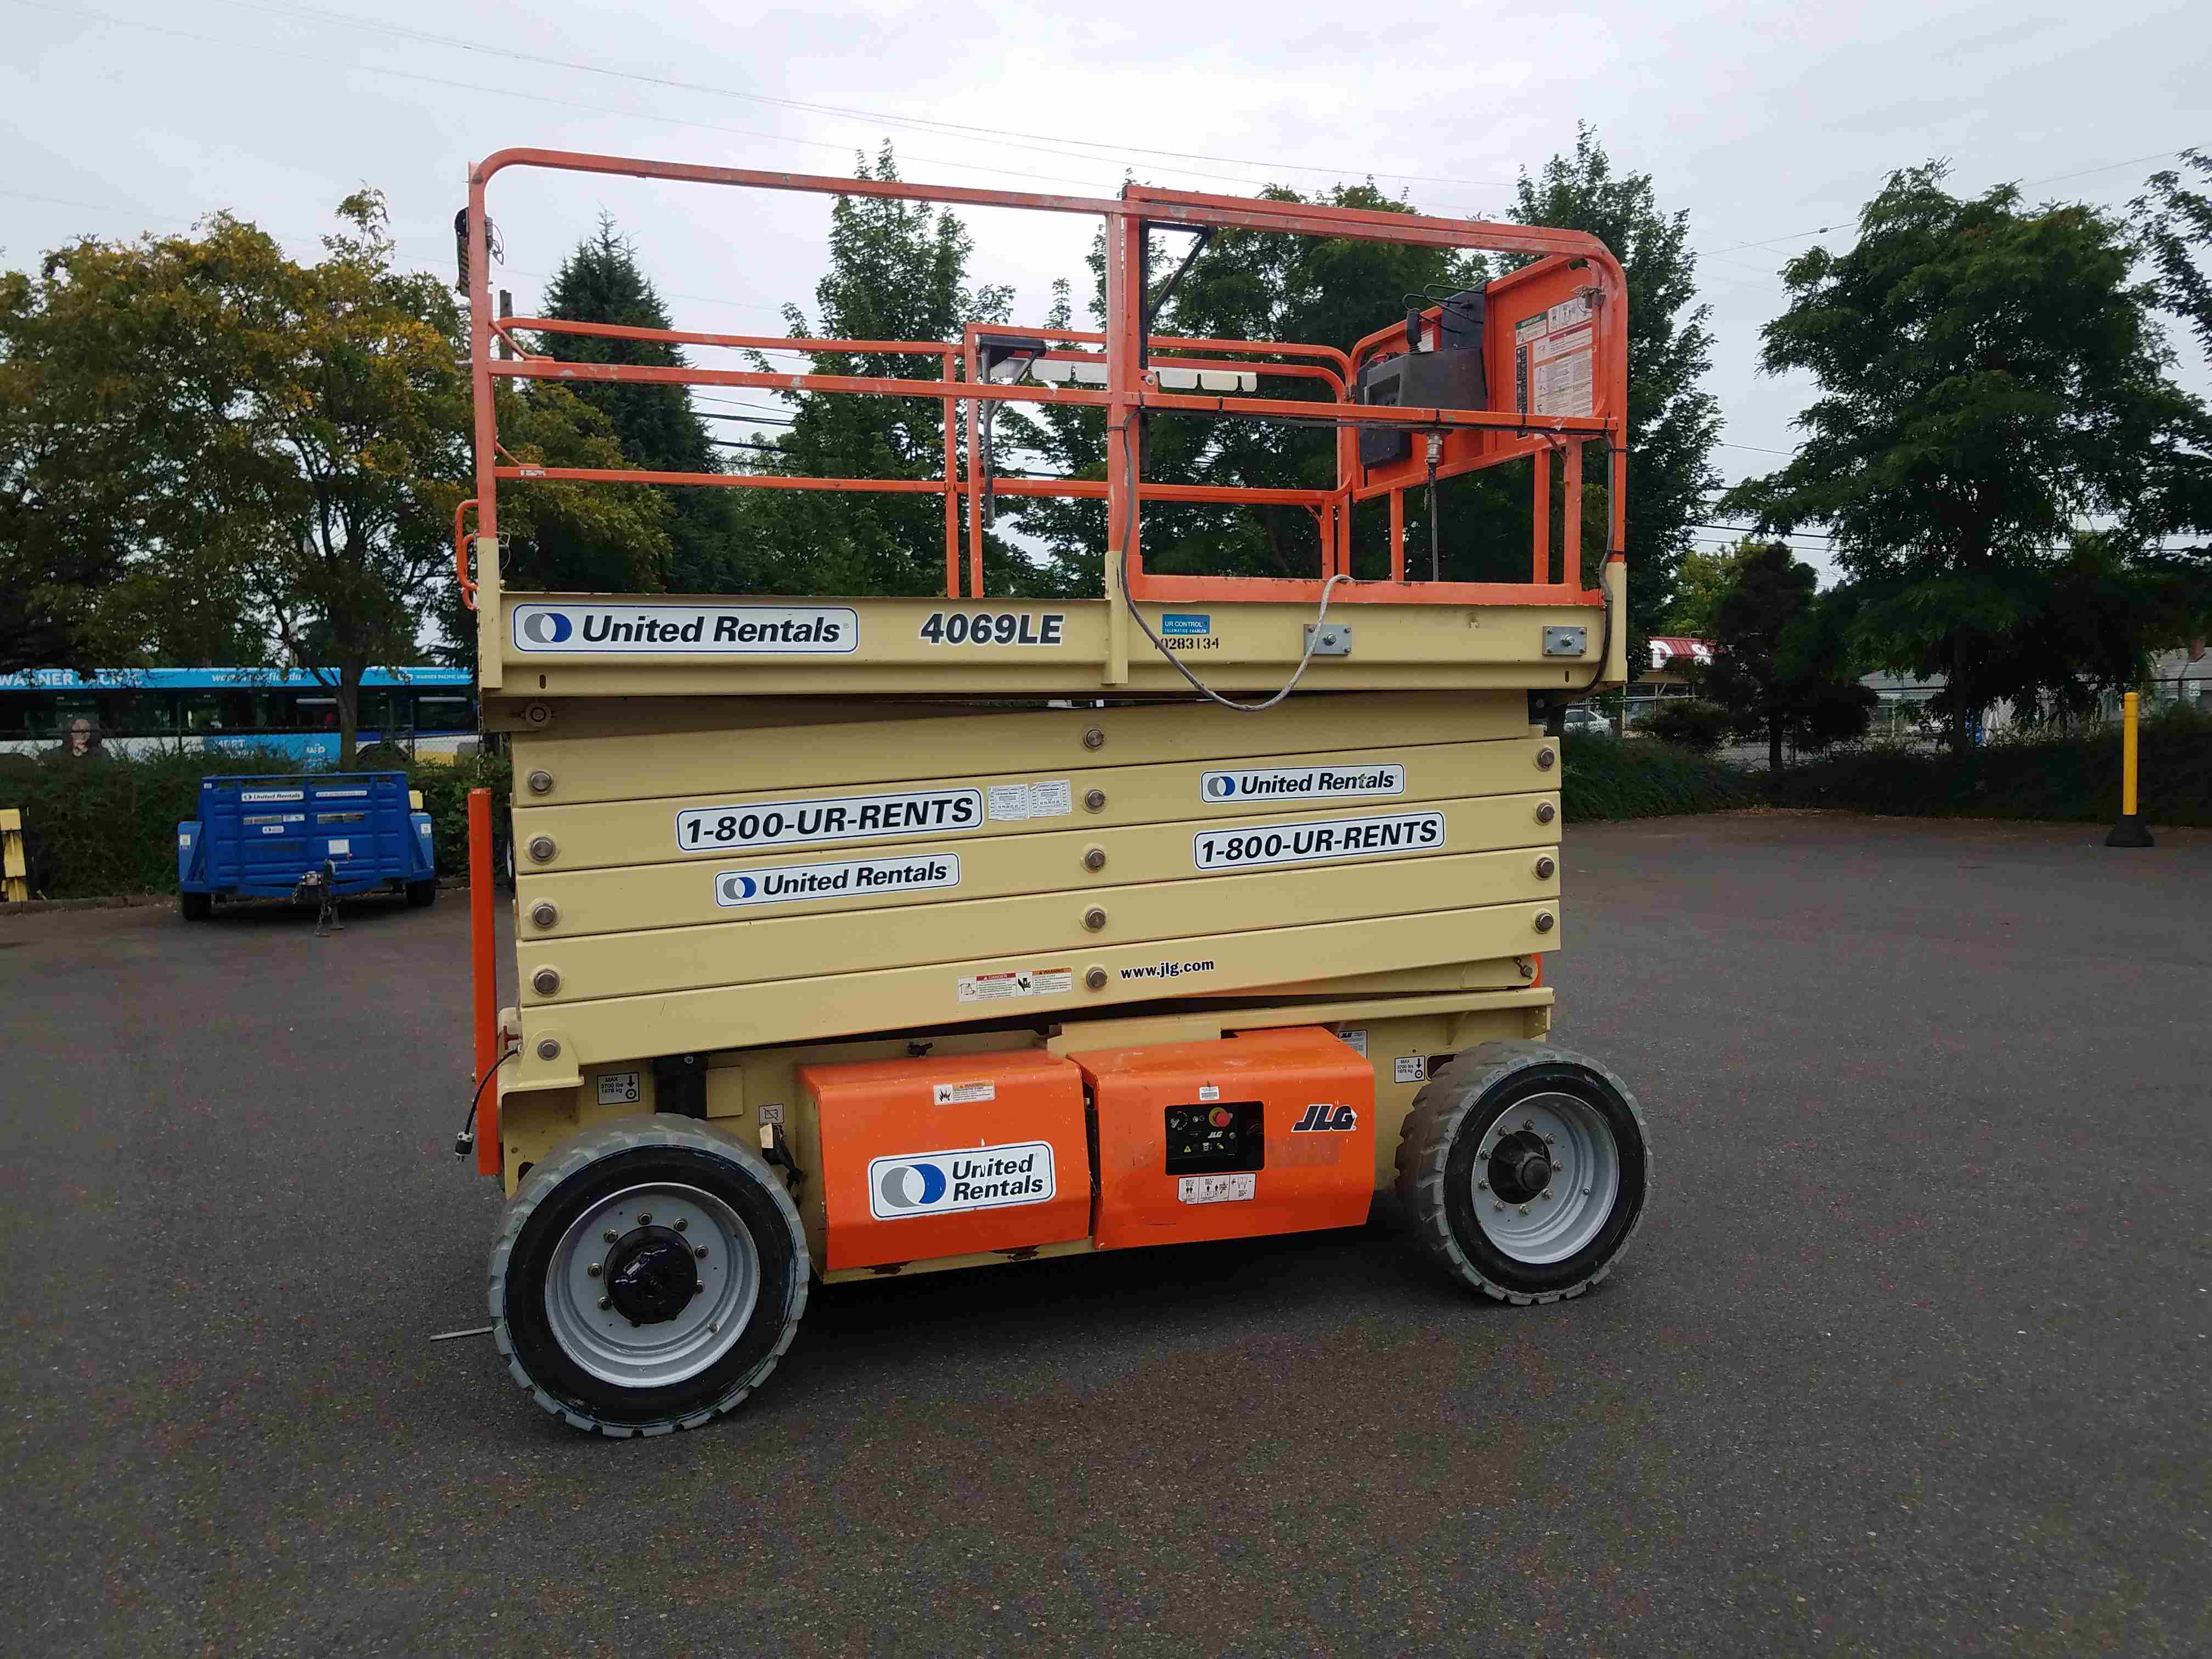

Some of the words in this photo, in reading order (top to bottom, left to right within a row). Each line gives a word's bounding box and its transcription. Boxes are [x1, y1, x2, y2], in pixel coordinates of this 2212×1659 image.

[583, 614, 705, 643] United
[713, 616, 842, 643] Rentals
[919, 613, 1065, 645] 4069LE
[0, 673, 74, 686] WANER
[1241, 774, 1312, 794] United
[1318, 771, 1395, 790] Rentals
[686, 797, 974, 843] 1-800-UR-RENTS
[1202, 820, 1437, 862] 1-800-UR-RENTS
[763, 869, 849, 895] United
[856, 861, 947, 886] Rentals
[1120, 960, 1214, 979] www.jlg.com
[1291, 1104, 1357, 1132] JLG
[952, 1154, 1033, 1180] United
[953, 1175, 1043, 1201] Rentals
